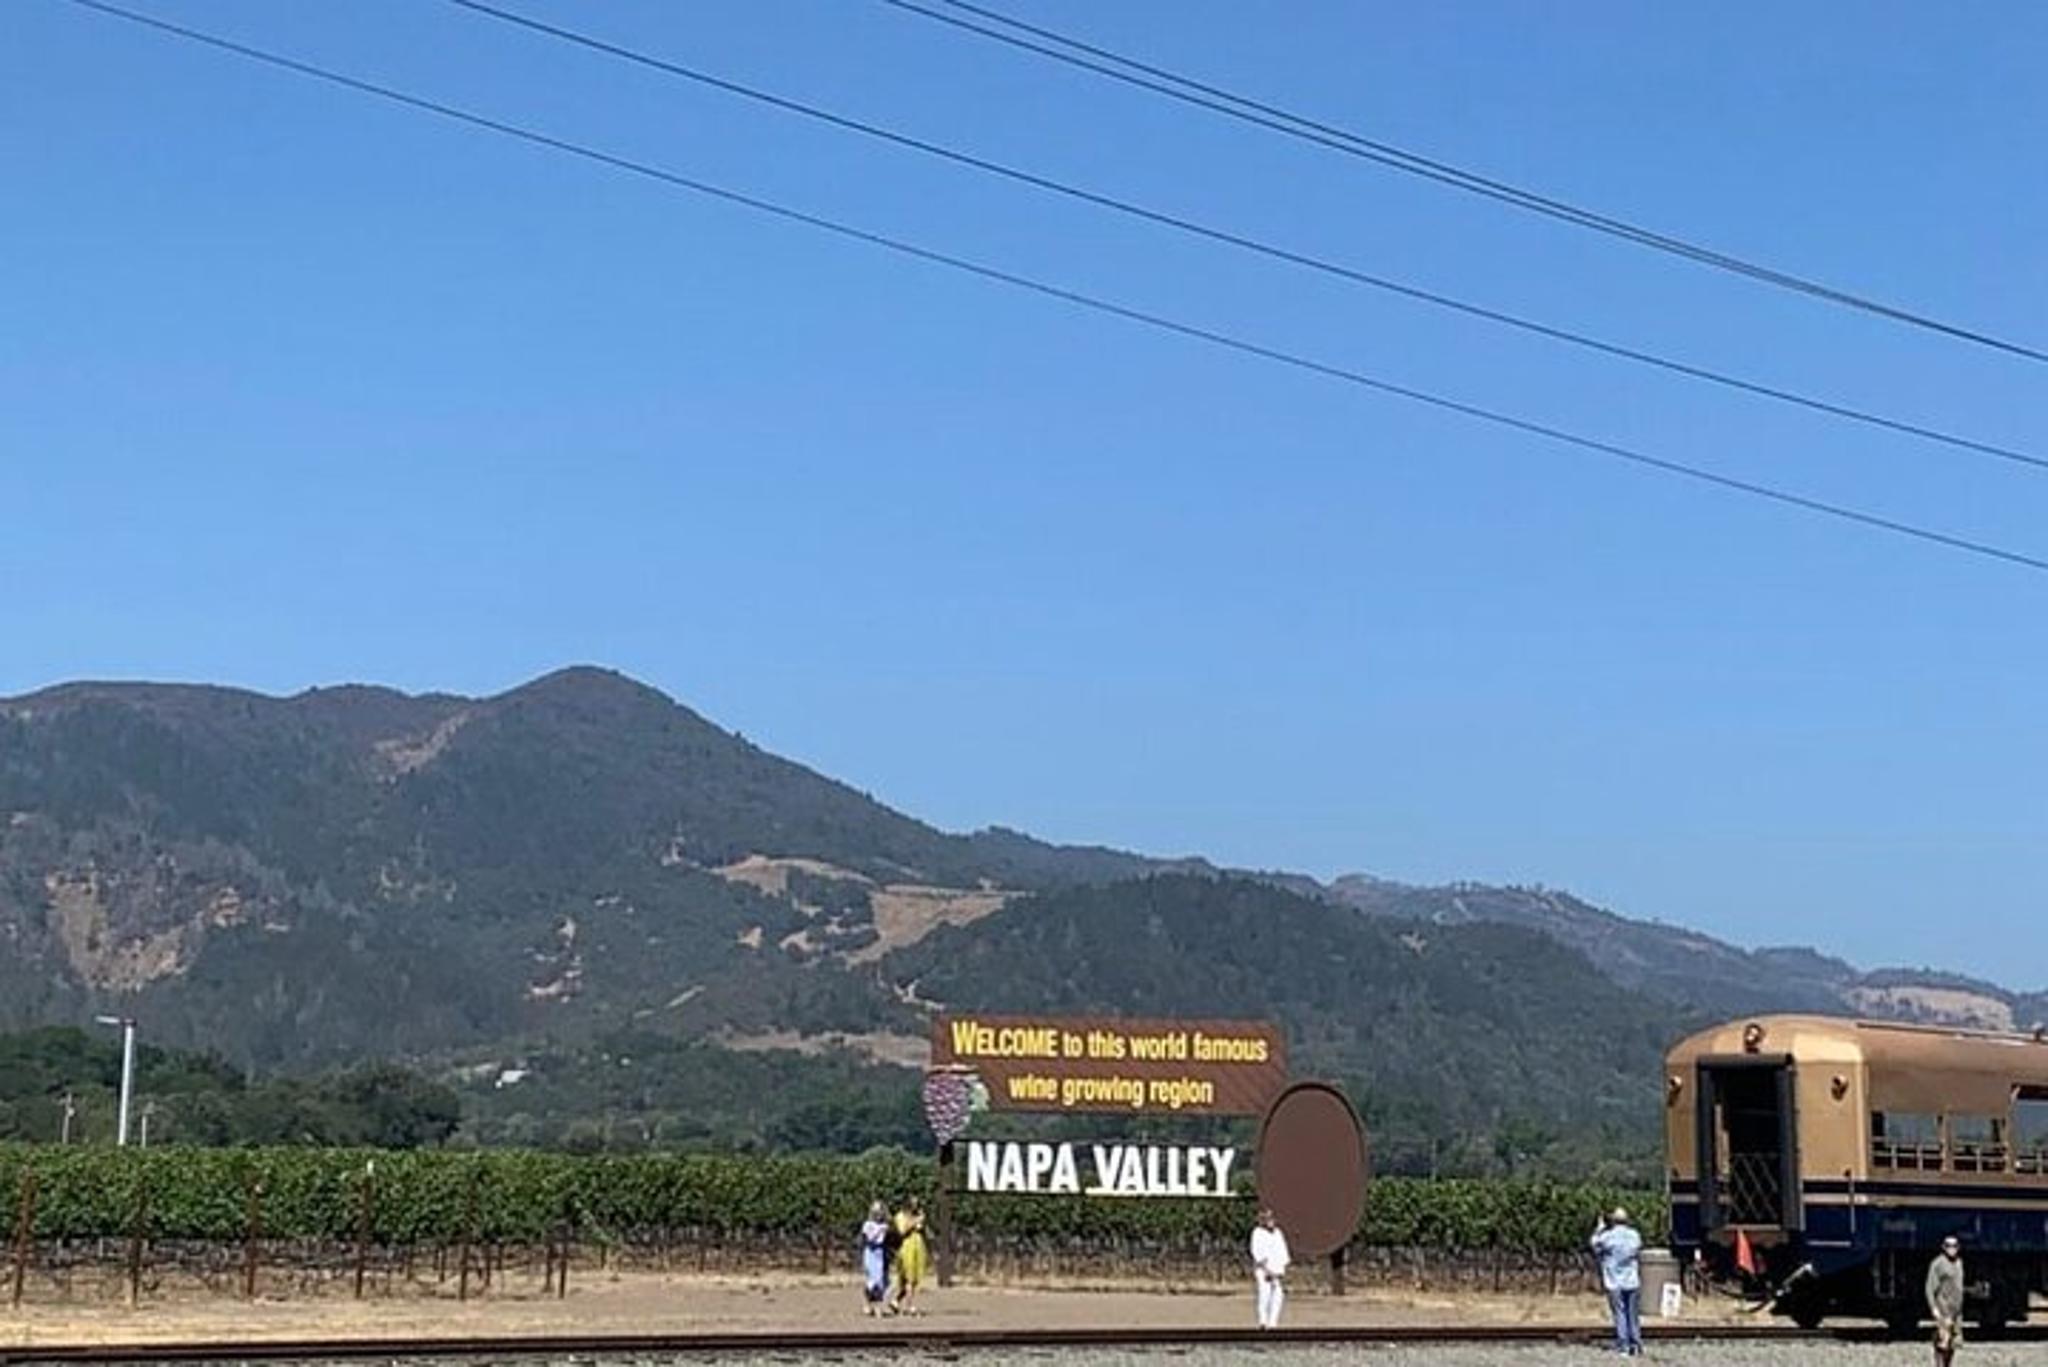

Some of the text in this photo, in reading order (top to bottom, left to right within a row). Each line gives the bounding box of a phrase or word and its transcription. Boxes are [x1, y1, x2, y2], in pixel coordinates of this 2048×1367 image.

[951, 1020, 1268, 1062] WELCOME to this world famous
[1008, 1074, 1214, 1107] wine growing region
[967, 1141, 1236, 1195] NAPA VALLEY
